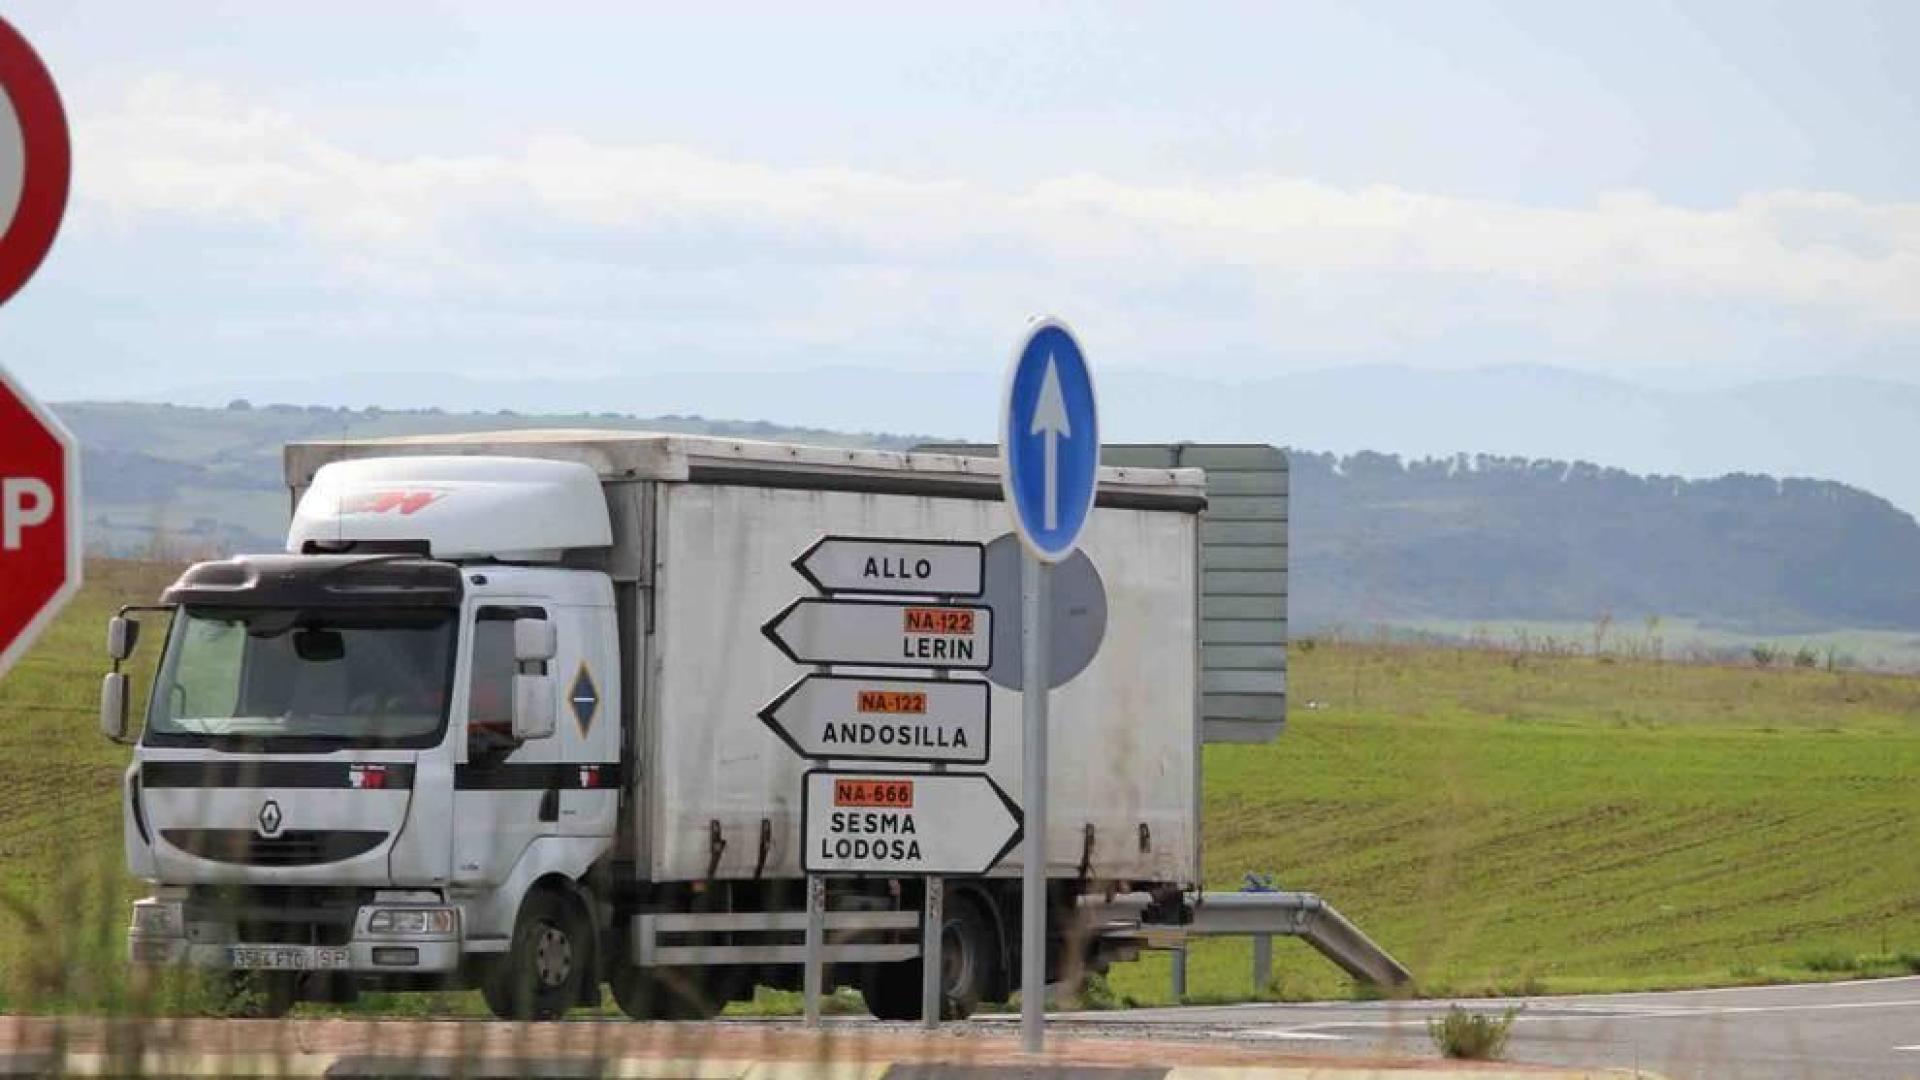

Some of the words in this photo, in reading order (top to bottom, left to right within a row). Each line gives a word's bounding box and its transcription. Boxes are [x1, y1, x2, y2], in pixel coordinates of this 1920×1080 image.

[862, 557, 931, 578] ALLO
[907, 611, 972, 631] NA-122
[904, 637, 973, 659] LERIN
[861, 694, 923, 712] NA-122
[822, 723, 968, 747] ANDOSILLA
[839, 784, 909, 802] NA-666
[830, 812, 916, 834] SESMA
[821, 838, 922, 860] LODOSA
